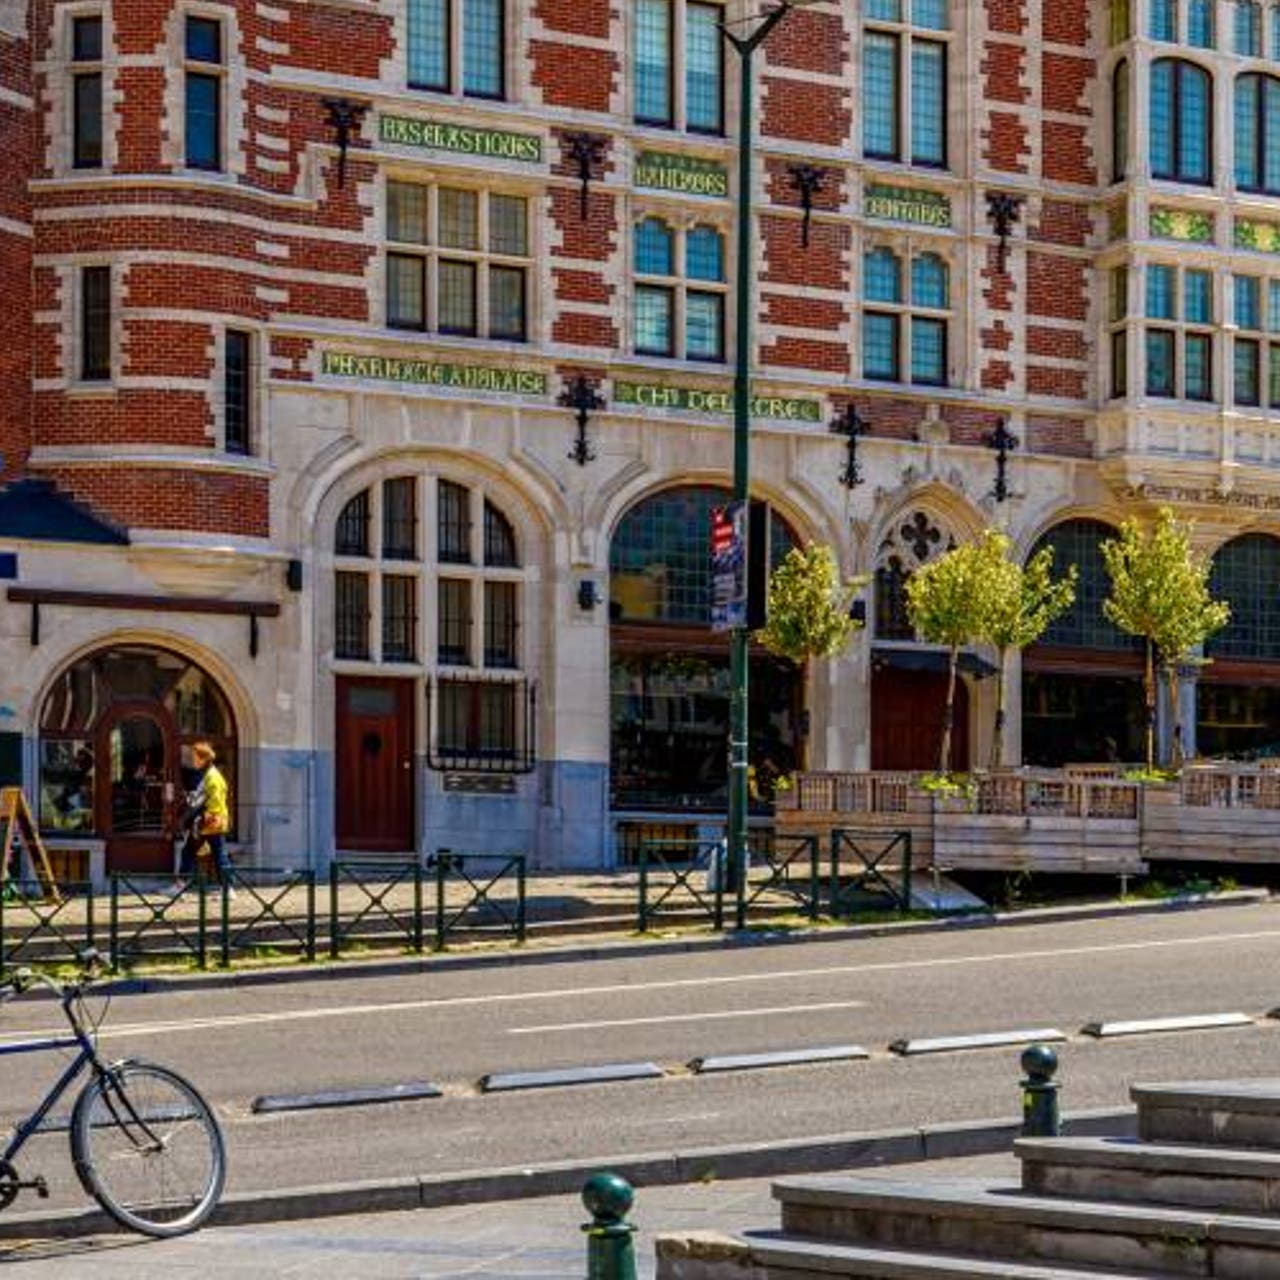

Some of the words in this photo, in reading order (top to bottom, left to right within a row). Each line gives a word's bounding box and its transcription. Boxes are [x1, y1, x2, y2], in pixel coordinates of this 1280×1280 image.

[326, 353, 445, 383] PHARMACIE
[450, 365, 545, 394] ANGLAISE
[687, 391, 800, 418] DELCRE
